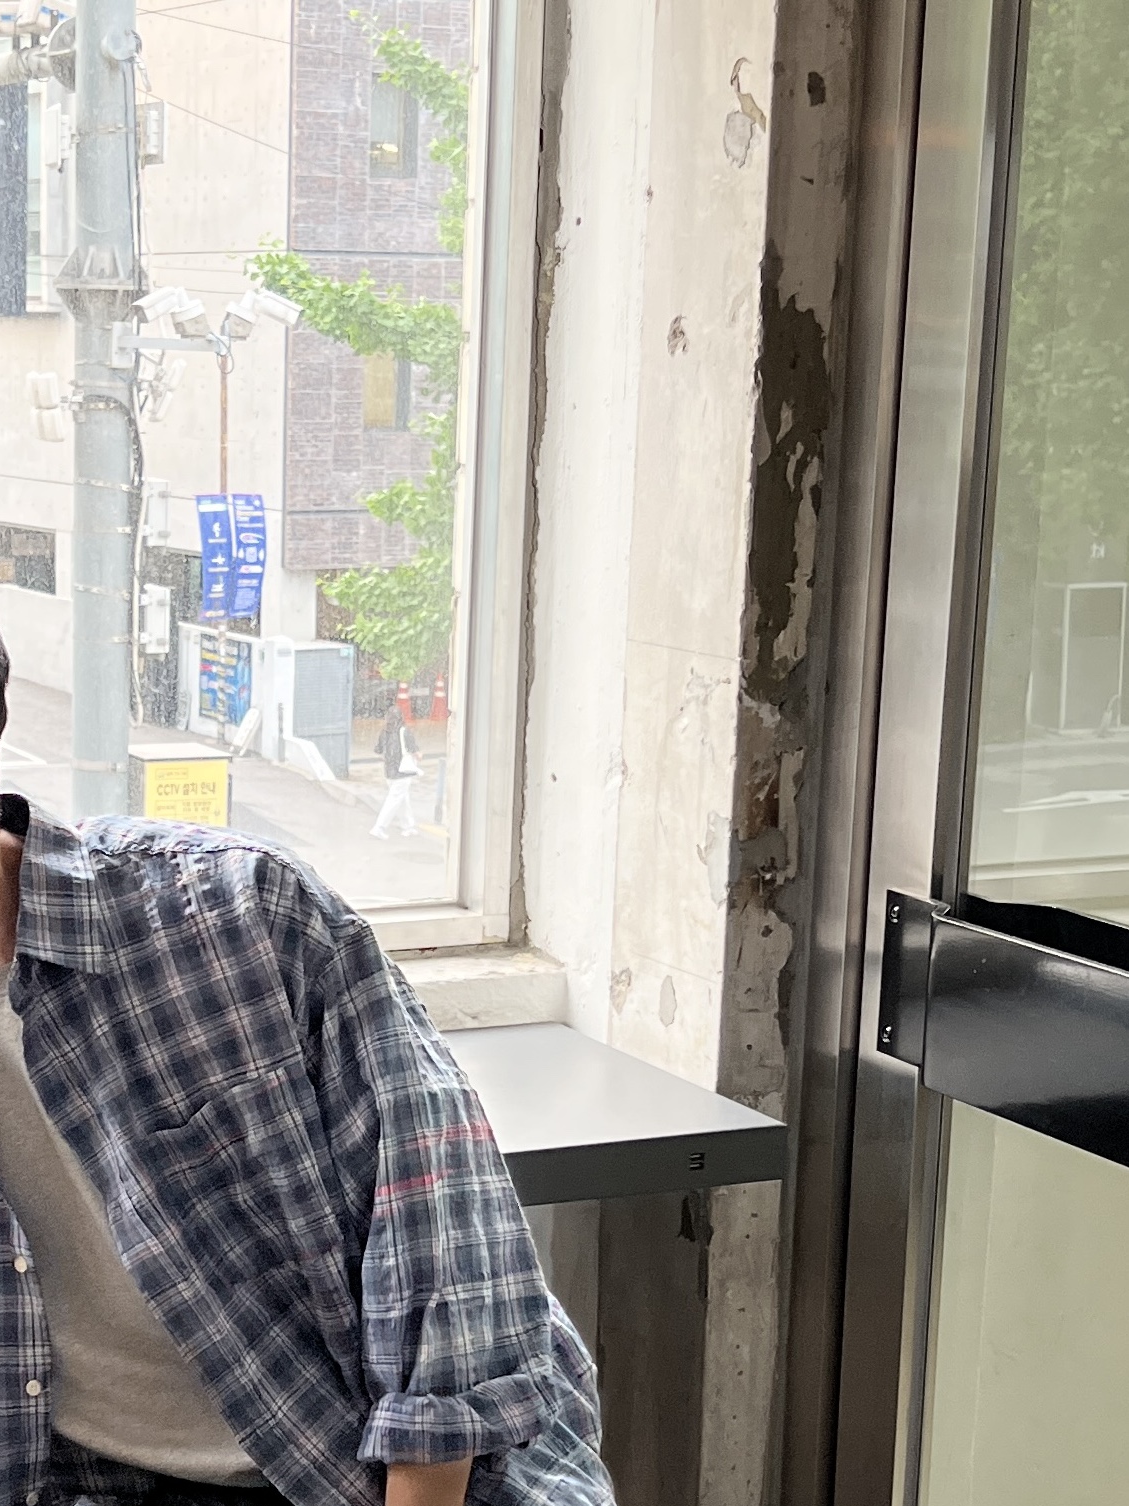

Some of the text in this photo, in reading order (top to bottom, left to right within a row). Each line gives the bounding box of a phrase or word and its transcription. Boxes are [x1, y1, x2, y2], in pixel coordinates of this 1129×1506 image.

[157, 781, 216, 796] CCTV 설치 안내
